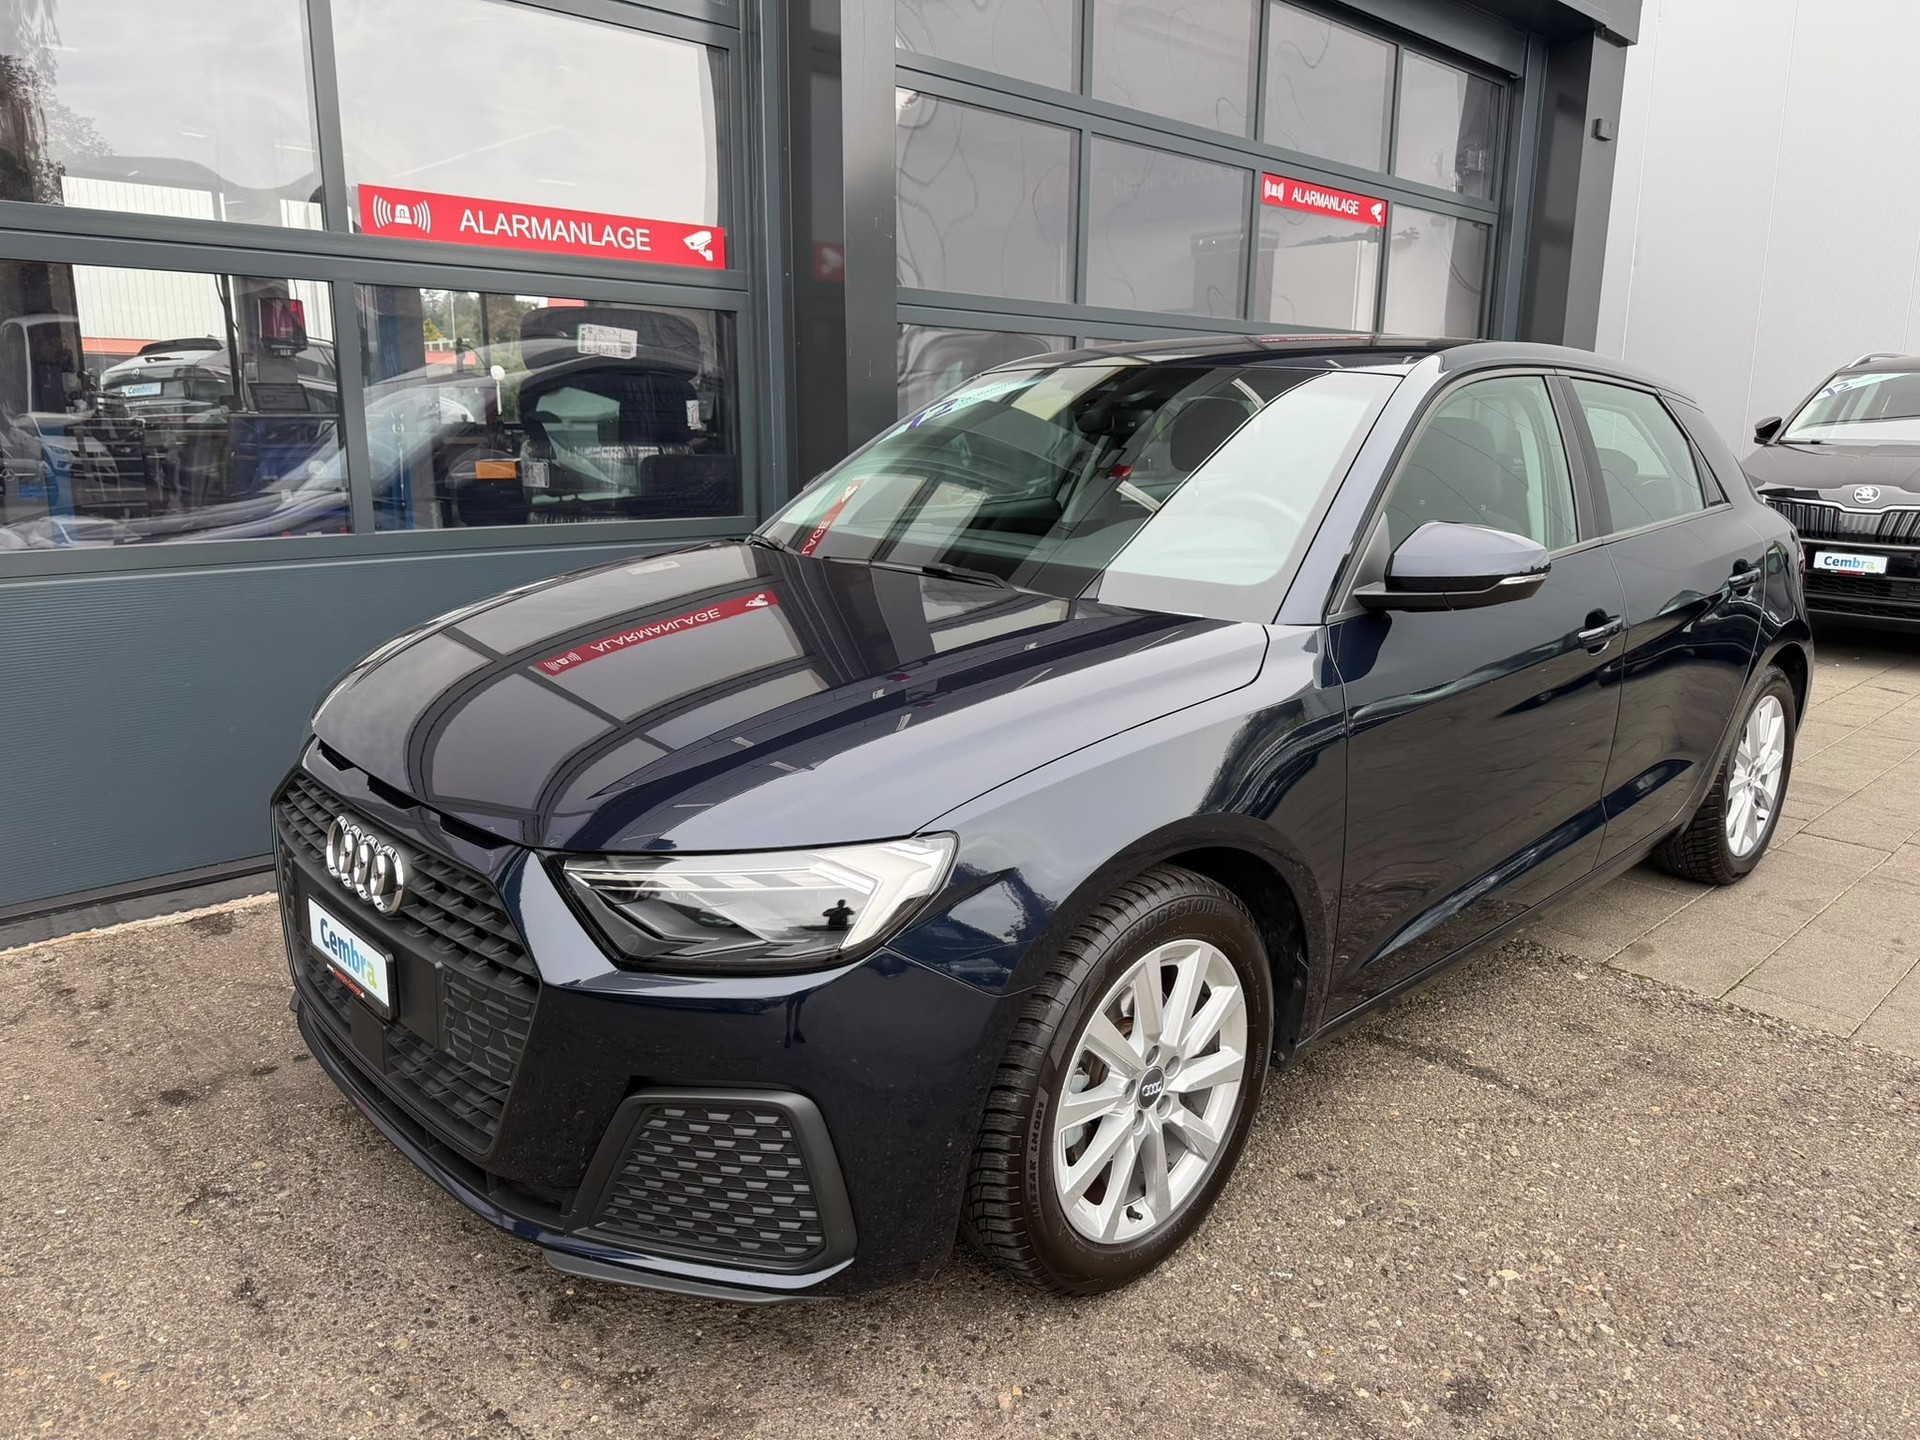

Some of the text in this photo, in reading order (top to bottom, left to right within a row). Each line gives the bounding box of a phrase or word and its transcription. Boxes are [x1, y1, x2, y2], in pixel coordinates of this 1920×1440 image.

[1291, 186, 1360, 215] ALARMANLAGE
[459, 208, 652, 251] ALARMANLAGE
[1823, 555, 1875, 570] Cembra
[320, 917, 378, 990] Cembra
